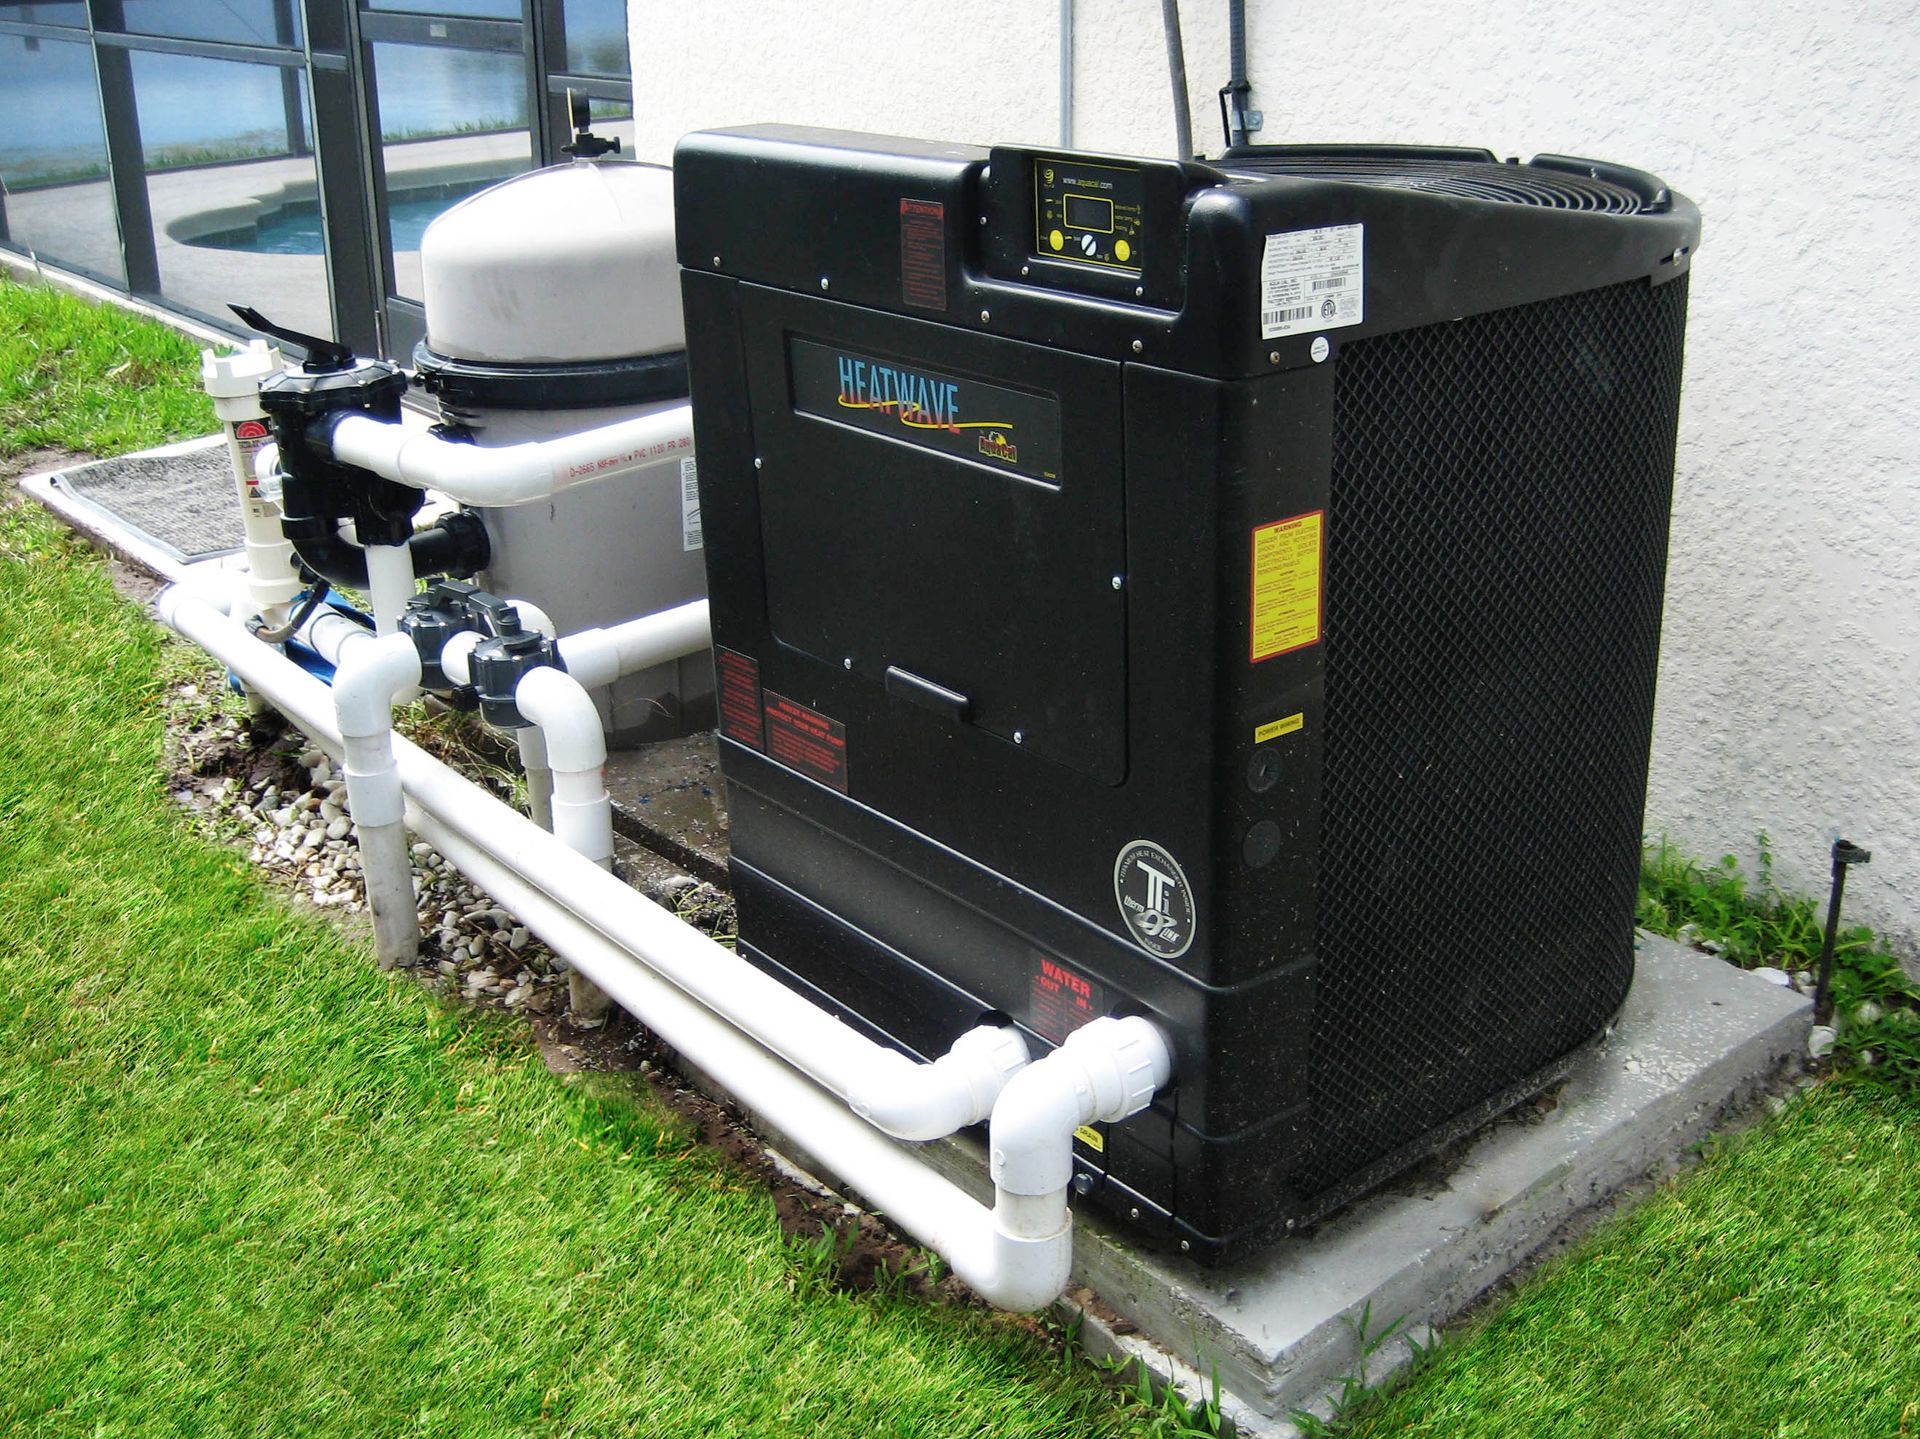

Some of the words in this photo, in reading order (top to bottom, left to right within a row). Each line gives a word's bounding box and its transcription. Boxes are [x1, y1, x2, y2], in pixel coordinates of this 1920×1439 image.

[838, 356, 961, 435] HEATWAVE
[634, 448, 647, 459] PVC
[1274, 521, 1303, 533] WARNING
[1040, 977, 1060, 993] OUT
[1076, 995, 1088, 1010] IN
[1041, 959, 1091, 998] WATER
